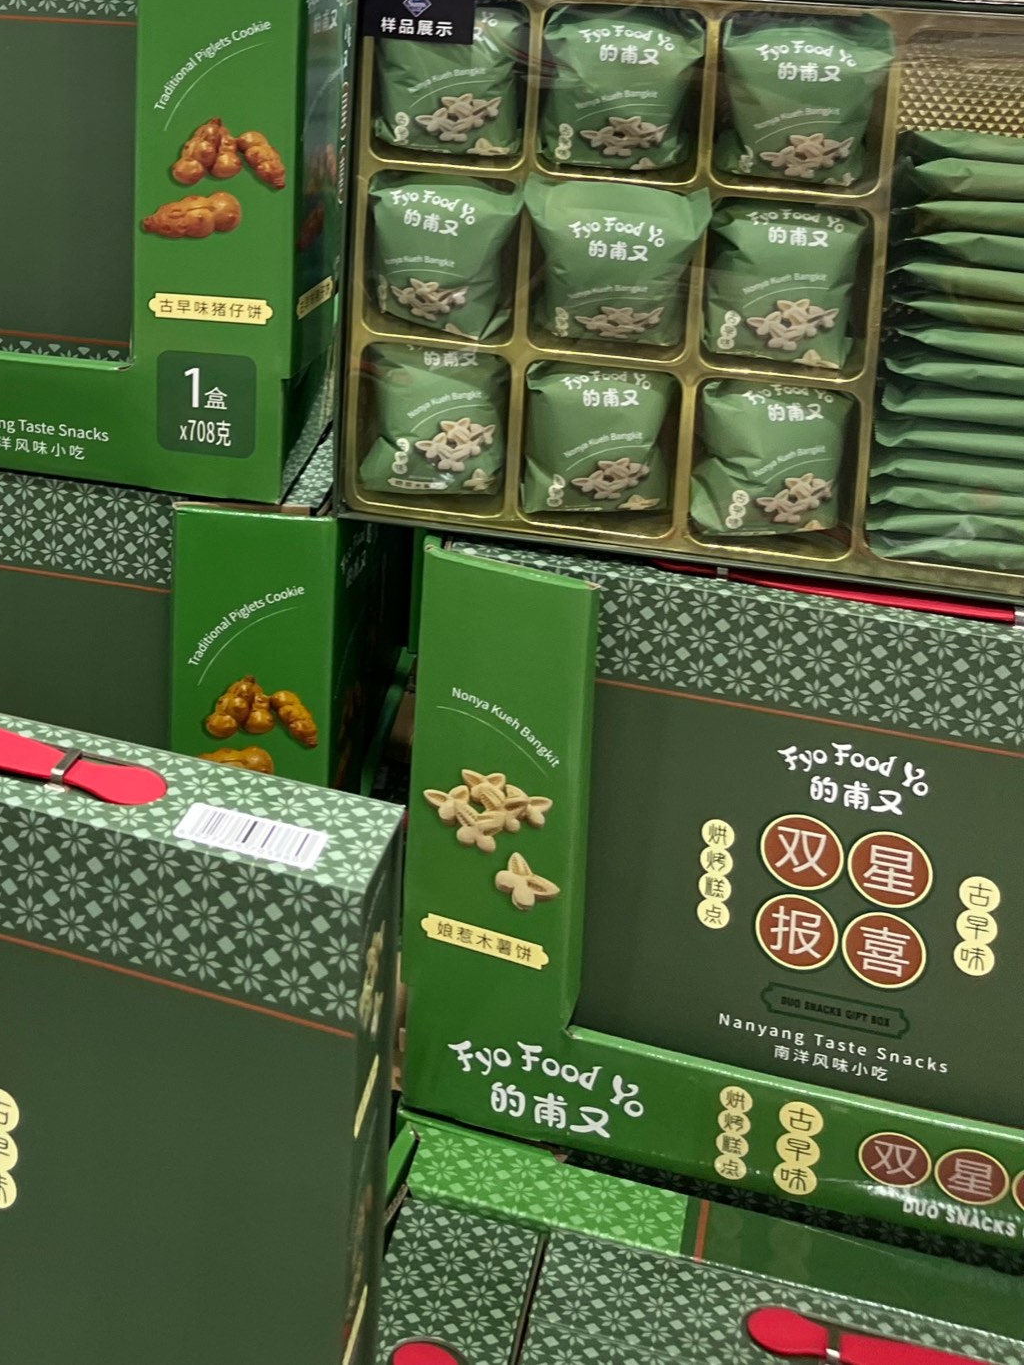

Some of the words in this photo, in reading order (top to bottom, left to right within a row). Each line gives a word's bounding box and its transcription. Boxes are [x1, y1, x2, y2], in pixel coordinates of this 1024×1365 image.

[380, 16, 454, 37] 样品展示
[154, 57, 198, 110] Traditional
[194, 36, 232, 62] Piglets
[231, 20, 272, 41] Cookie
[159, 298, 263, 321] 古早味猪仔饼
[183, 366, 228, 411] 1盒
[179, 420, 232, 448] x708克
[188, 618, 231, 666] Traditional
[228, 598, 266, 622] Piglets
[265, 585, 305, 605] Cookie
[451, 686, 490, 711] Nonya
[490, 703, 521, 731] Kueh
[519, 724, 562, 769] Bangkit
[774, 824, 918, 897] 双星
[436, 920, 534, 962] 娘惹木薯饼
[769, 905, 910, 978] 报喜
[718, 1012, 805, 1046] Nanyang
[814, 1033, 867, 1058] Taste
[876, 1046, 948, 1074] Snacks
[903, 1198, 938, 1219] DUO
[946, 1204, 1016, 1237] SNACKS
